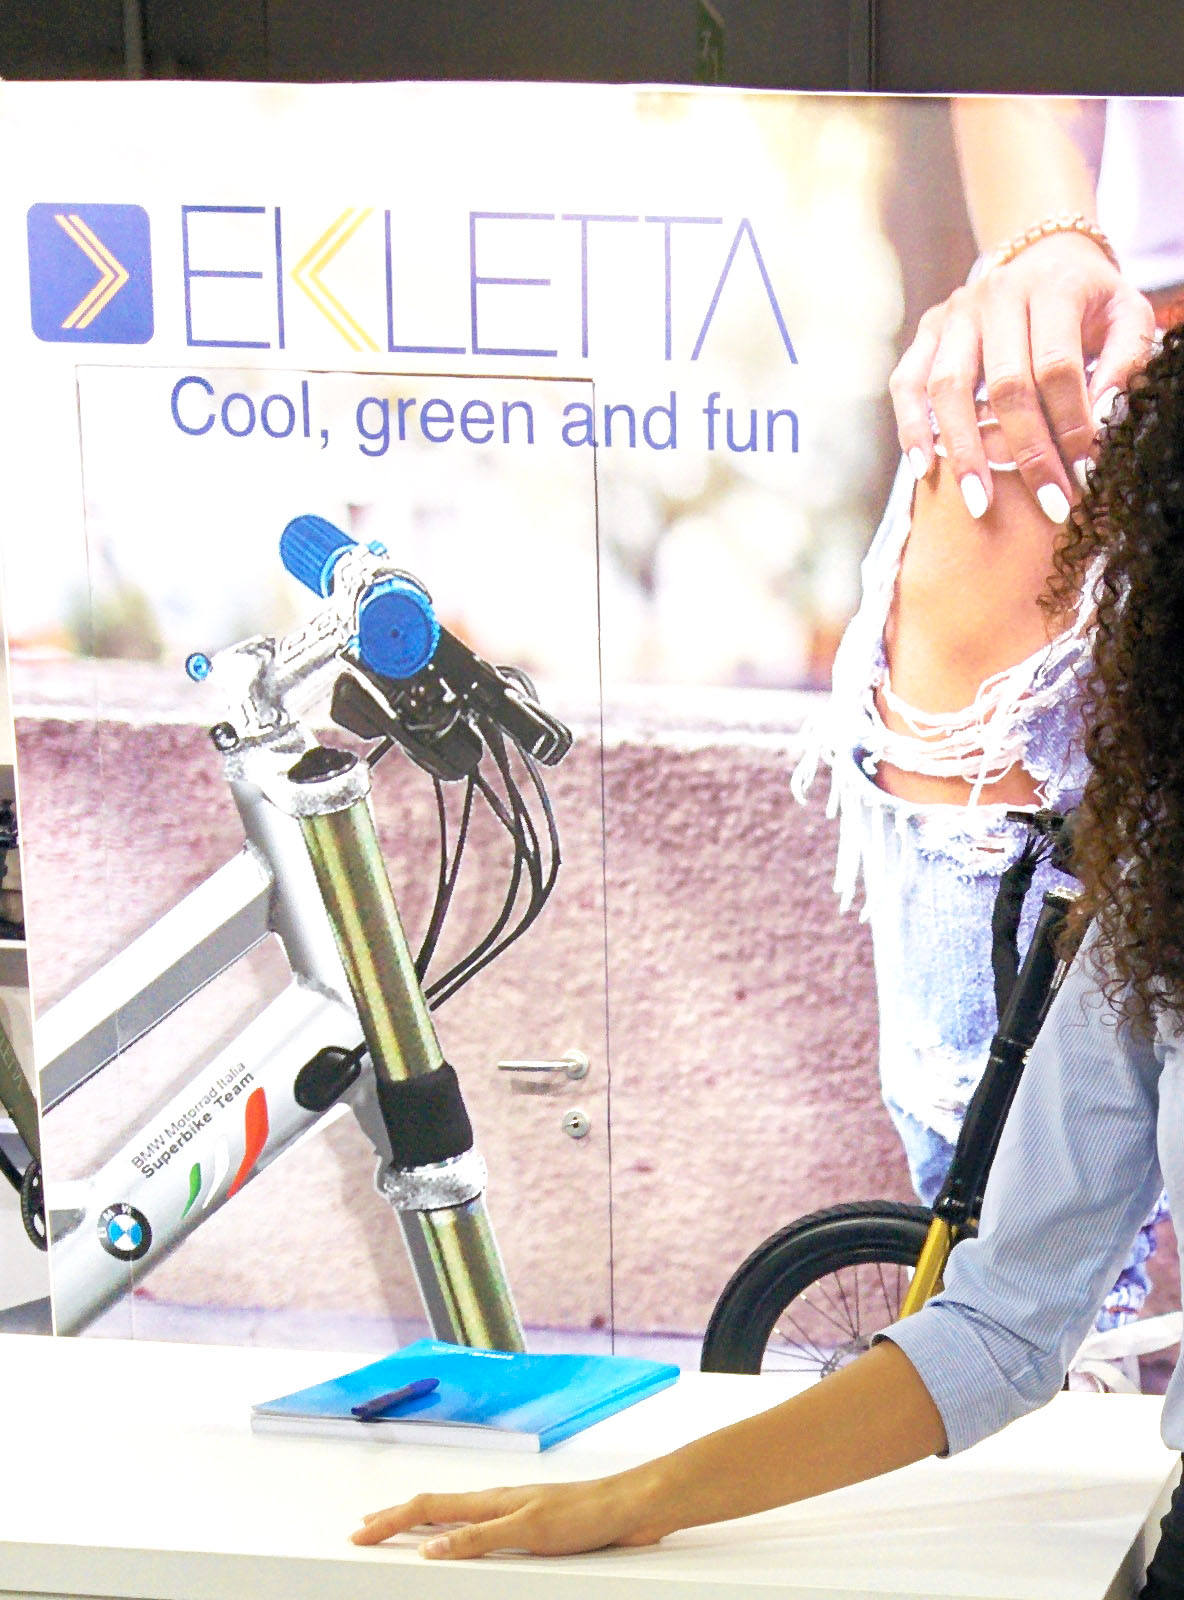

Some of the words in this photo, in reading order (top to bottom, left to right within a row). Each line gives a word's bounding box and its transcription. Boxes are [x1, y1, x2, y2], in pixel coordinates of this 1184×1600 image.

[181, 205, 799, 364] EKLETTA
[171, 376, 329, 448] Cool,
[356, 396, 535, 456] green
[562, 392, 678, 450] and
[704, 391, 799, 453] fun
[131, 1134, 166, 1170] BMW
[164, 1087, 219, 1139] Motorrad
[216, 1062, 247, 1091] Italia
[141, 1111, 213, 1179] Superbike
[213, 1072, 255, 1110] Team
